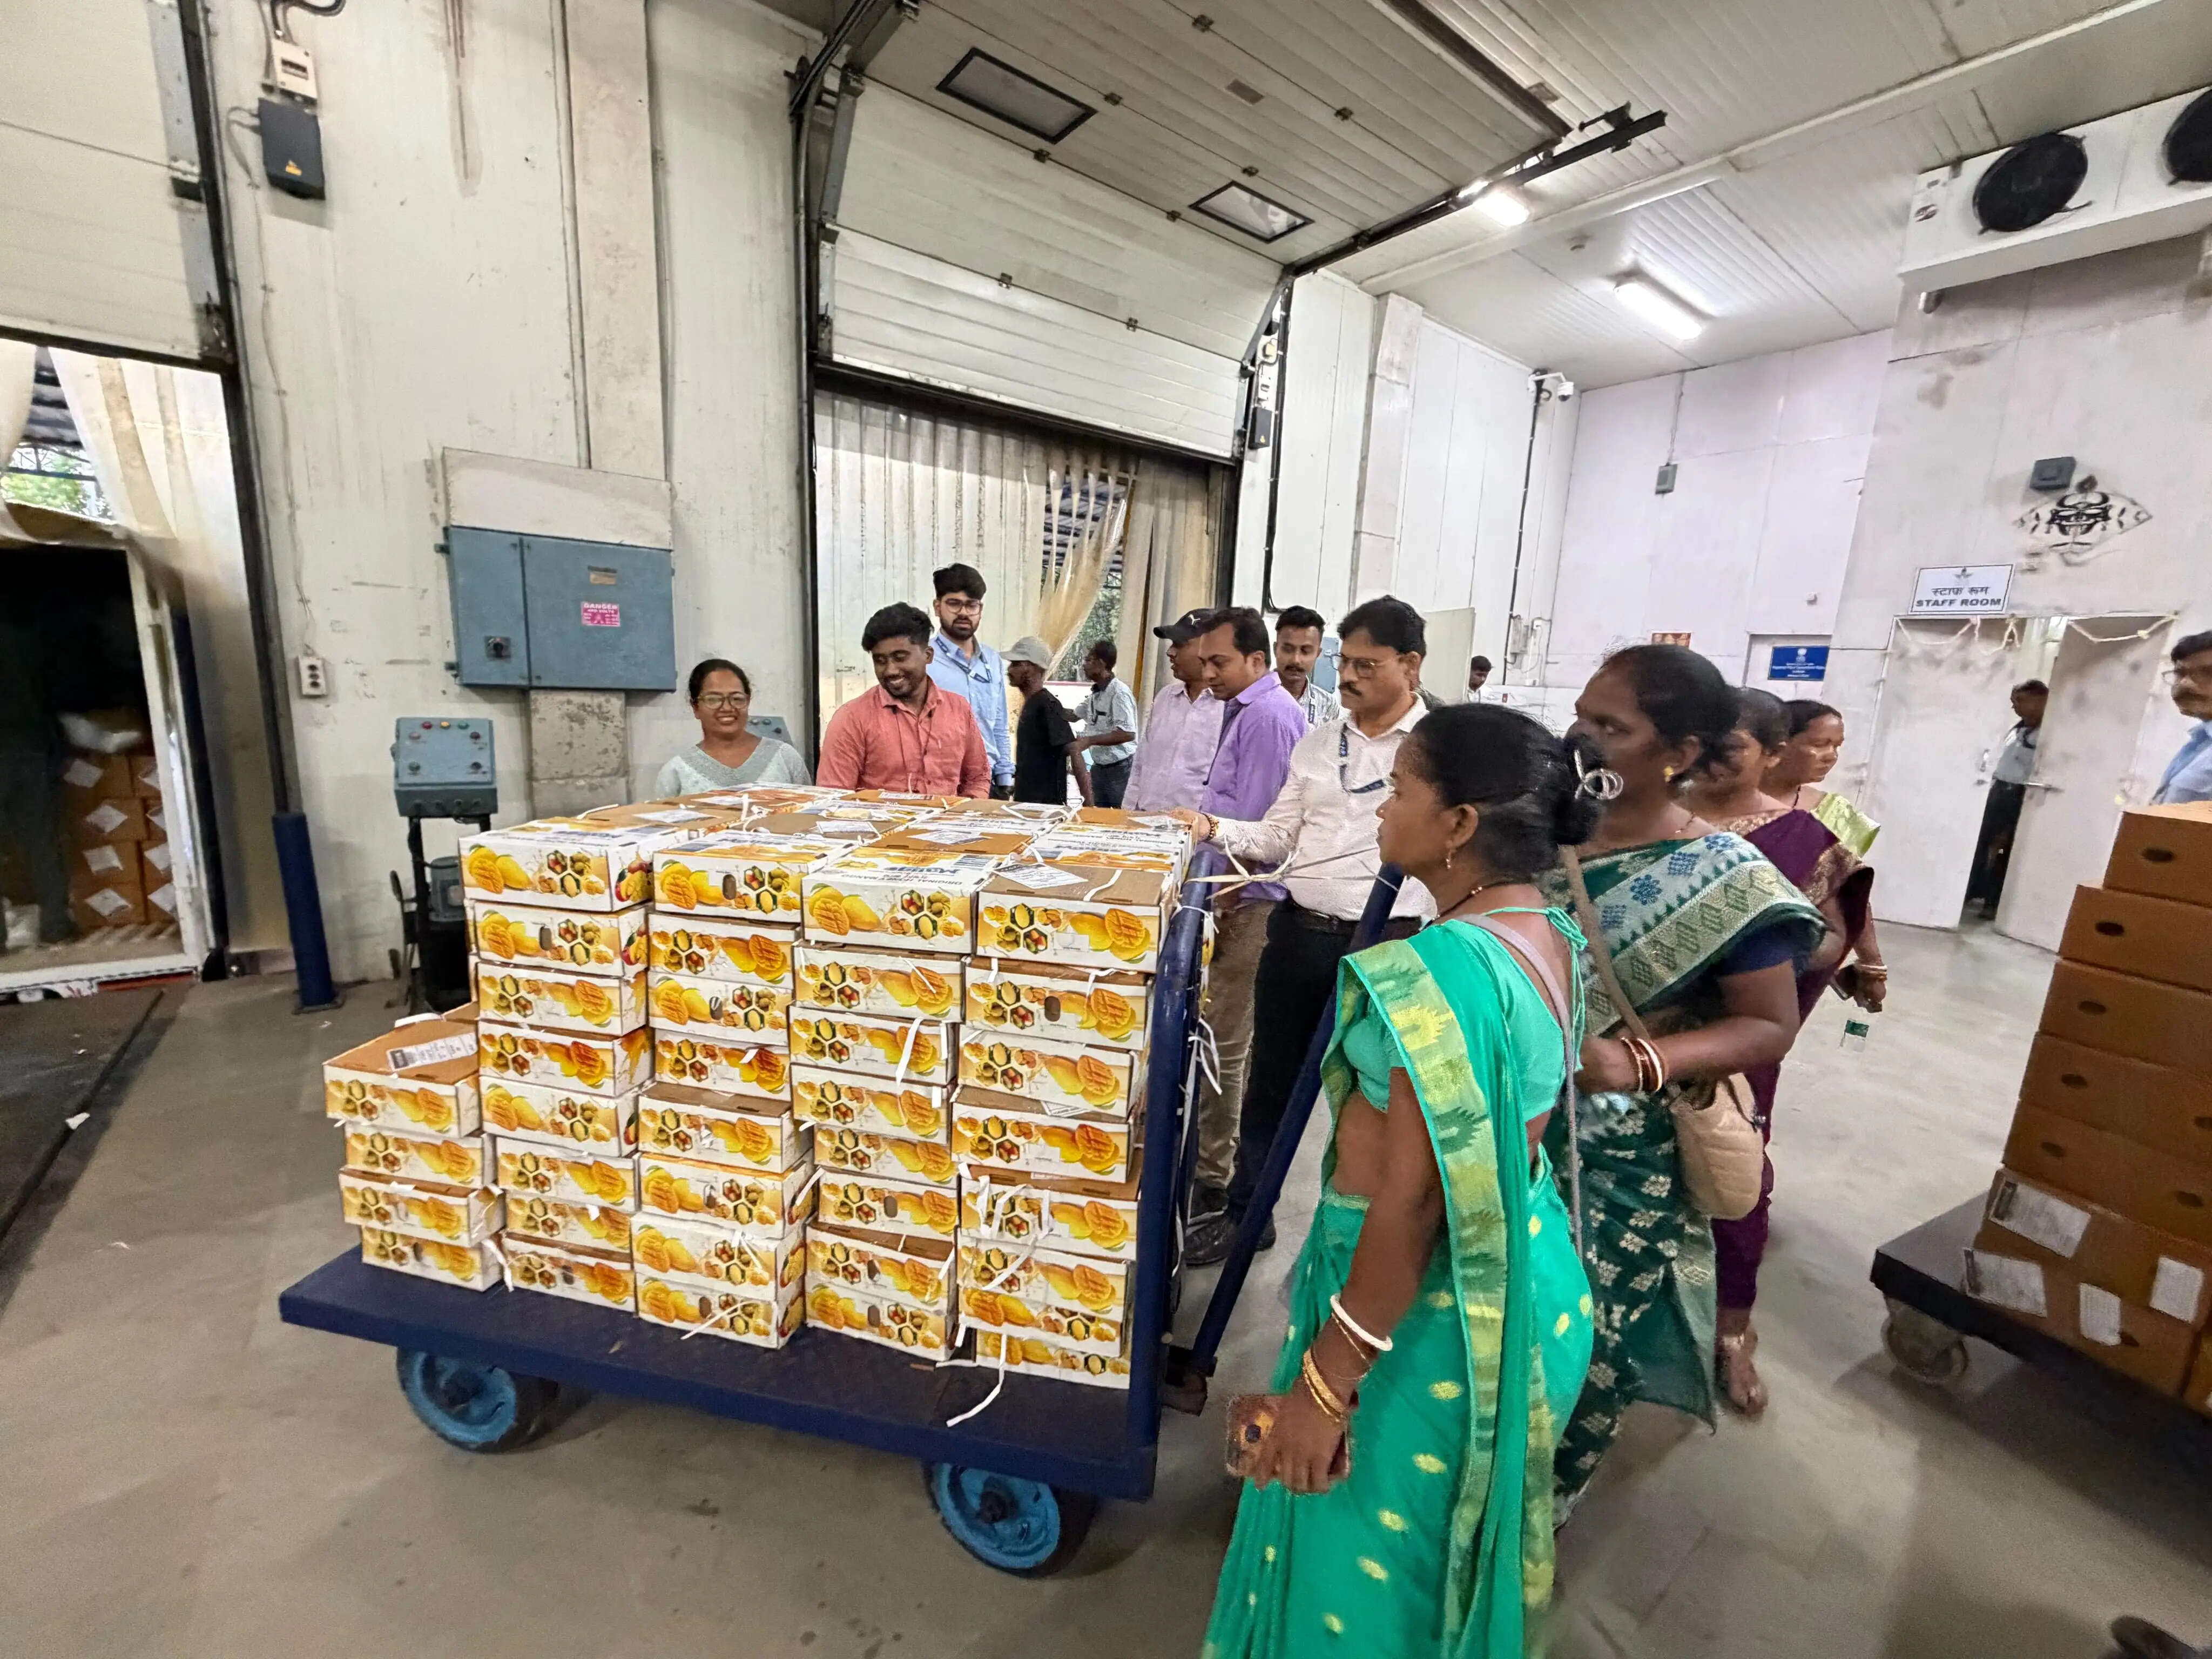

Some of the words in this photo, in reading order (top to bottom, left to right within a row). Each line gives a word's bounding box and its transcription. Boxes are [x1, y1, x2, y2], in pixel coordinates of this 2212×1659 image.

[1968, 586, 1991, 595] रूम
[1916, 599, 1958, 607] STAFF
[1960, 598, 2001, 606] ROOM
